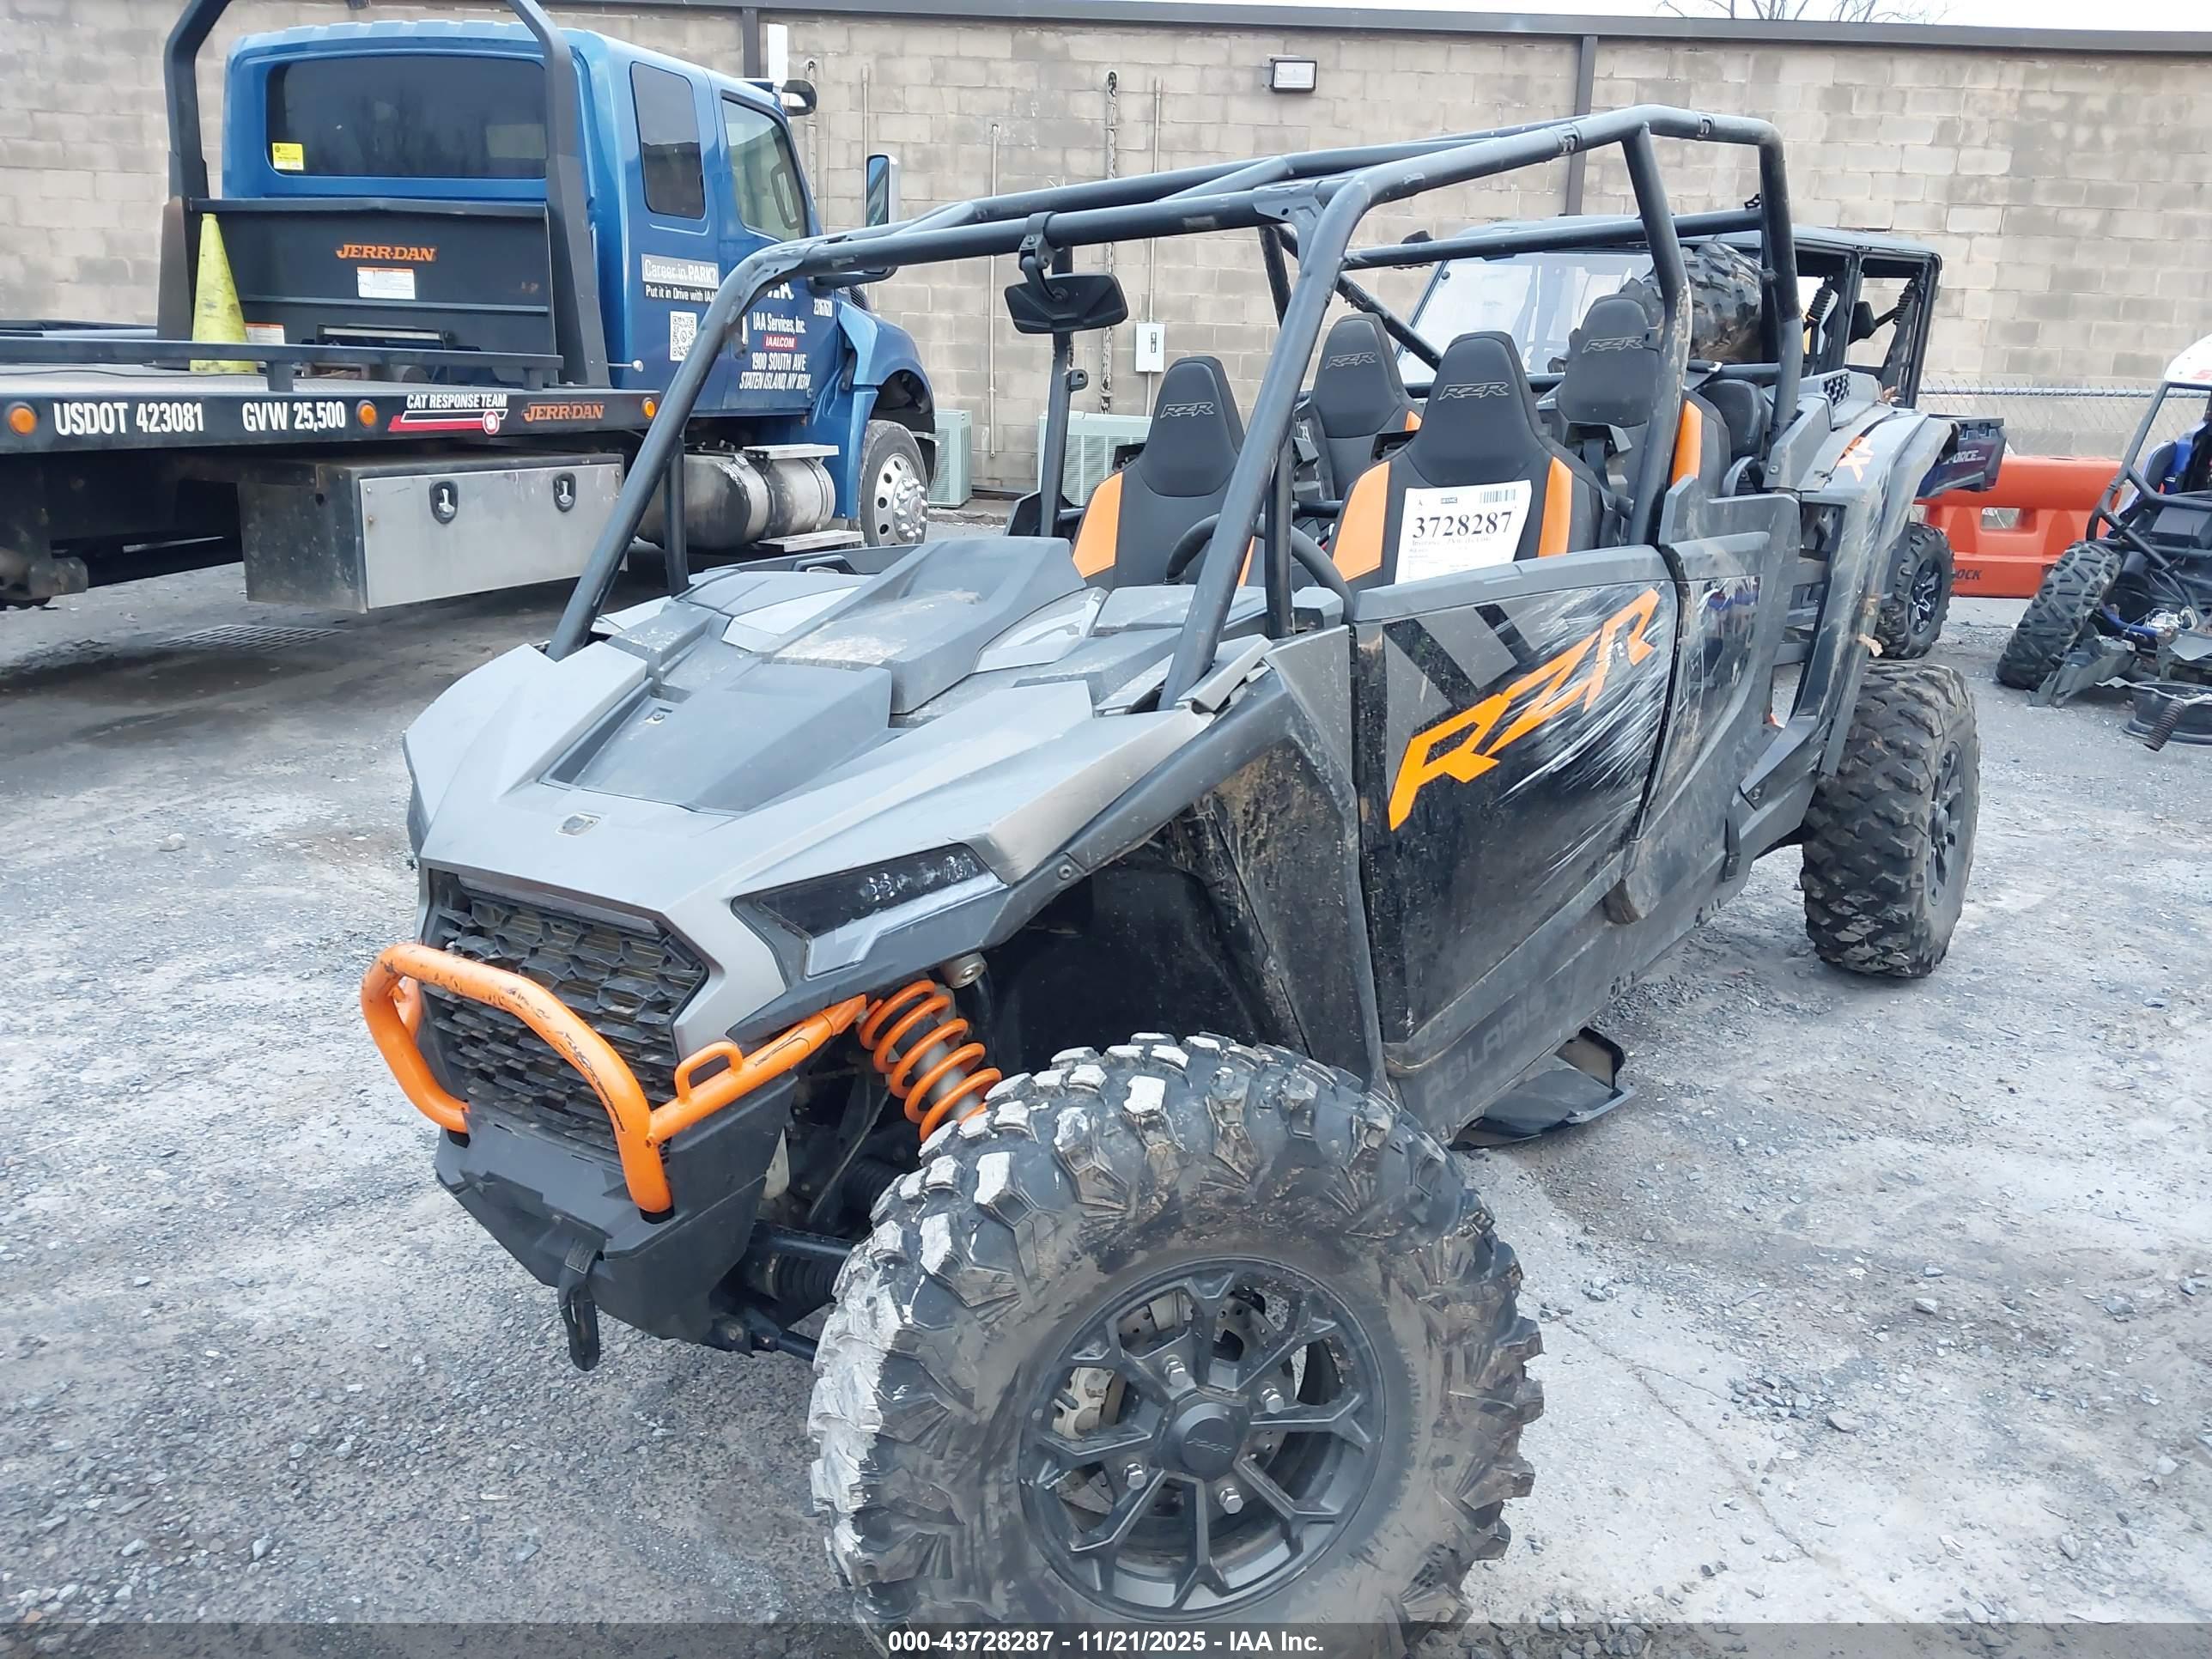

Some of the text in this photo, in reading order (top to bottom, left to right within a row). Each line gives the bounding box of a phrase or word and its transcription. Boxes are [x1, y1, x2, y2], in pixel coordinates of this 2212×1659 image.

[644, 258, 717, 284] Career in PARK?
[645, 284, 718, 302] Put it in Drive with IAA
[752, 311, 767, 331] IAA
[767, 313, 795, 335] Services,
[795, 316, 806, 334] Inc.
[751, 352, 807, 371] 1900 SOUTH AVE
[739, 371, 764, 390] STATEN
[763, 372, 788, 392] ISLAND,
[786, 373, 798, 390] NY
[406, 393, 508, 409] CAT RESPONSE TEAM
[53, 402, 204, 436] USDOT 423081
[241, 401, 346, 432] GVW 25,500
[1412, 511, 1512, 538] 3728287
[1388, 587, 1661, 831] RZR
